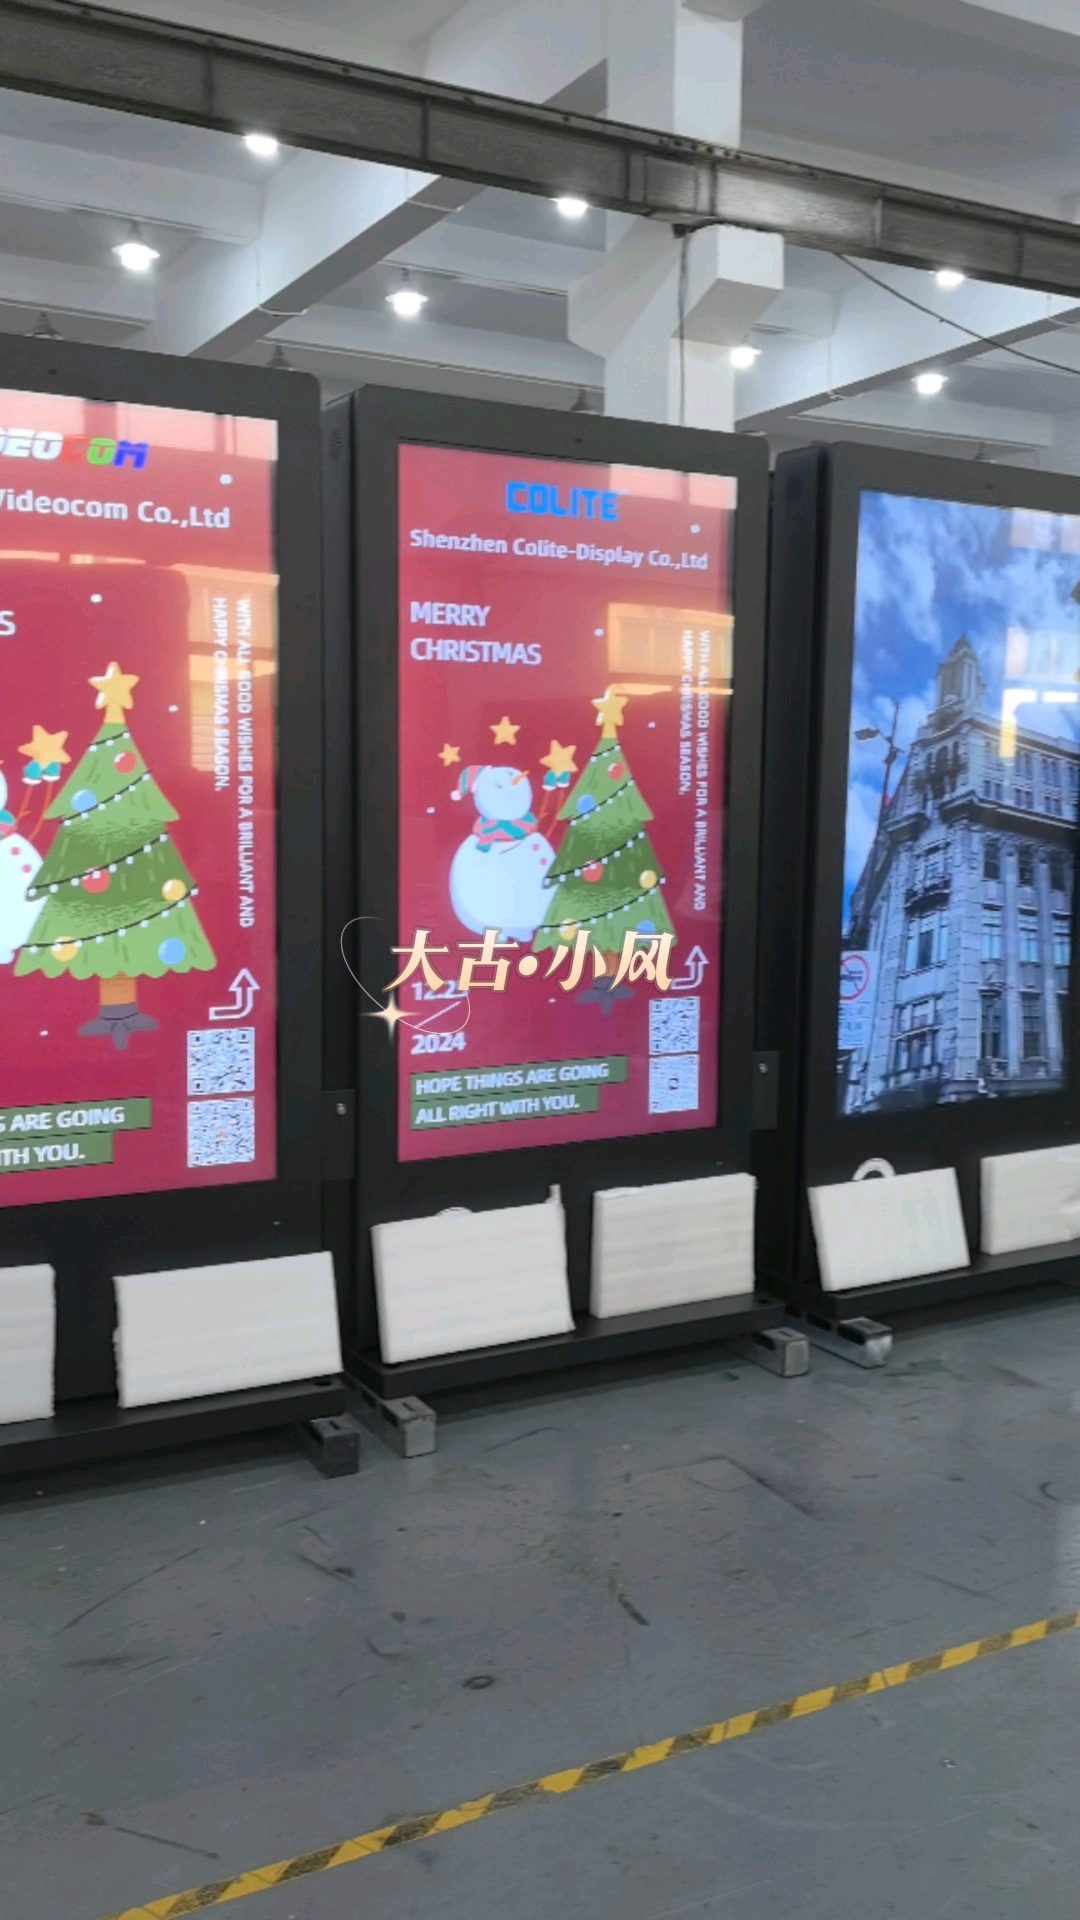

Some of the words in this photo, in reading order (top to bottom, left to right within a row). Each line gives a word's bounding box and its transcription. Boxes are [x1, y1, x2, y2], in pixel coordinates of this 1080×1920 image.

[137, 501, 230, 529] Co.,Ltd
[506, 481, 619, 522] COLITE
[410, 529, 507, 554] Shenzhen
[513, 538, 644, 568] Colite-Display
[648, 550, 708, 570] Co.,Ltd
[213, 597, 228, 646] HAPPY
[237, 598, 252, 636] WITH
[410, 601, 491, 627] MERRY
[410, 638, 542, 665] CHRISTMAS
[682, 630, 693, 671] HAPPY
[698, 630, 711, 662] WITH
[237, 670, 252, 714] GOOD
[697, 693, 710, 728] GOOD
[238, 718, 253, 771] WISHES
[696, 732, 709, 778] WISHES
[238, 776, 253, 804] FOR
[695, 781, 708, 806] FOR
[238, 807, 253, 819] A
[695, 808, 708, 819] A
[238, 822, 254, 893] BRILLIANT
[694, 821, 708, 881] BRILLIANT
[239, 896, 254, 928] AND
[694, 883, 706, 911] AND
[410, 1031, 466, 1055] 2024
[416, 1075, 462, 1095] HOPE
[464, 1070, 523, 1090] THINGS
[525, 1067, 557, 1084] ARE
[559, 1063, 609, 1081] GOING
[9, 1112, 53, 1132] ARE
[56, 1107, 125, 1128] GOING
[415, 1107, 447, 1124] ALL
[449, 1101, 500, 1121] RIGHT
[500, 1097, 540, 1115] WITH
[542, 1094, 580, 1110] YOU.
[32, 1143, 86, 1162] YOU.
